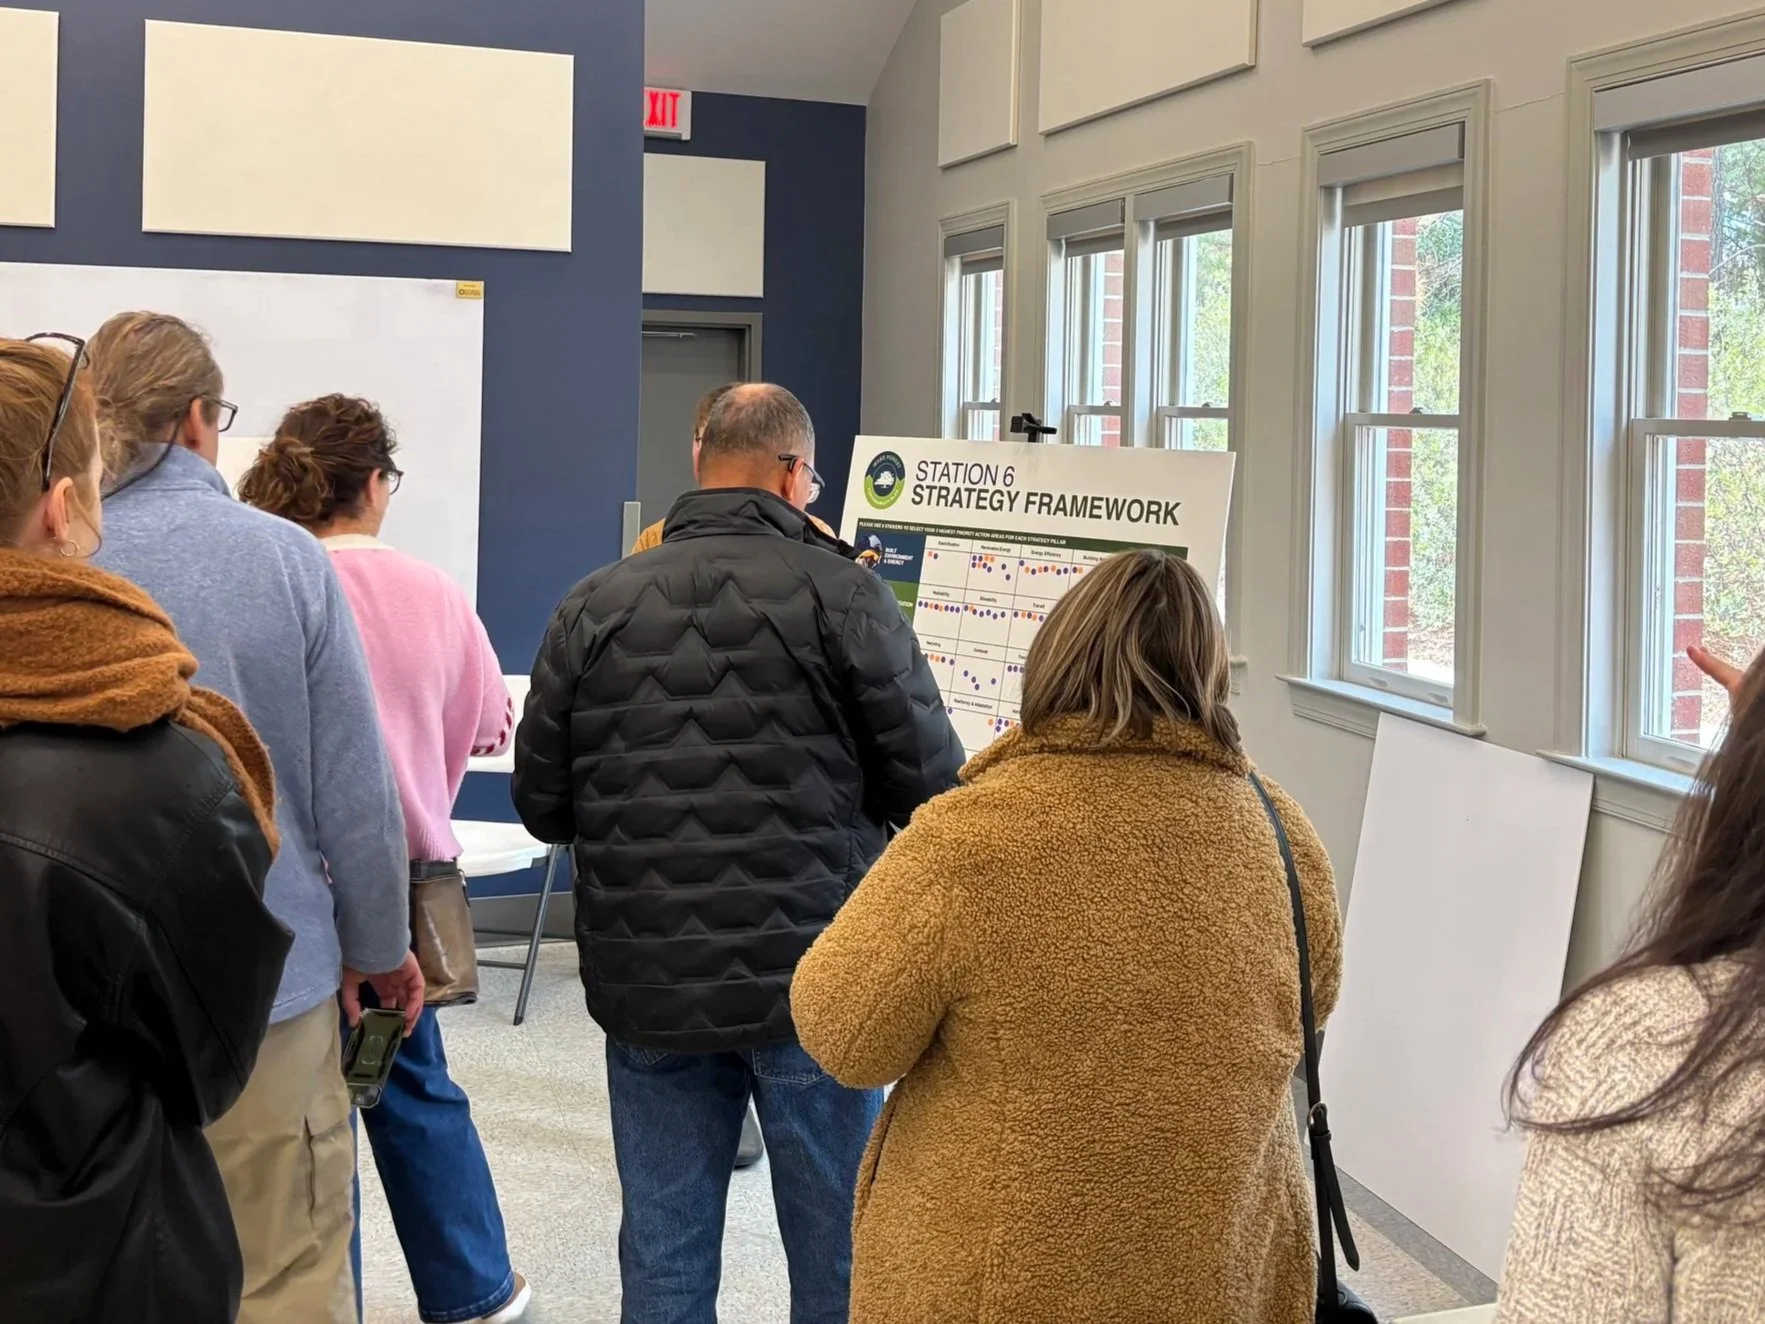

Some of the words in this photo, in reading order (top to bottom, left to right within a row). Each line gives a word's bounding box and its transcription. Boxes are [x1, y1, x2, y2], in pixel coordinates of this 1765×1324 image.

[645, 91, 681, 128] XIT
[916, 460, 999, 486] STATION
[1003, 466, 1016, 488] 6
[911, 484, 1020, 513] STRATEGY
[1024, 492, 1182, 526] FRAMEWORK
